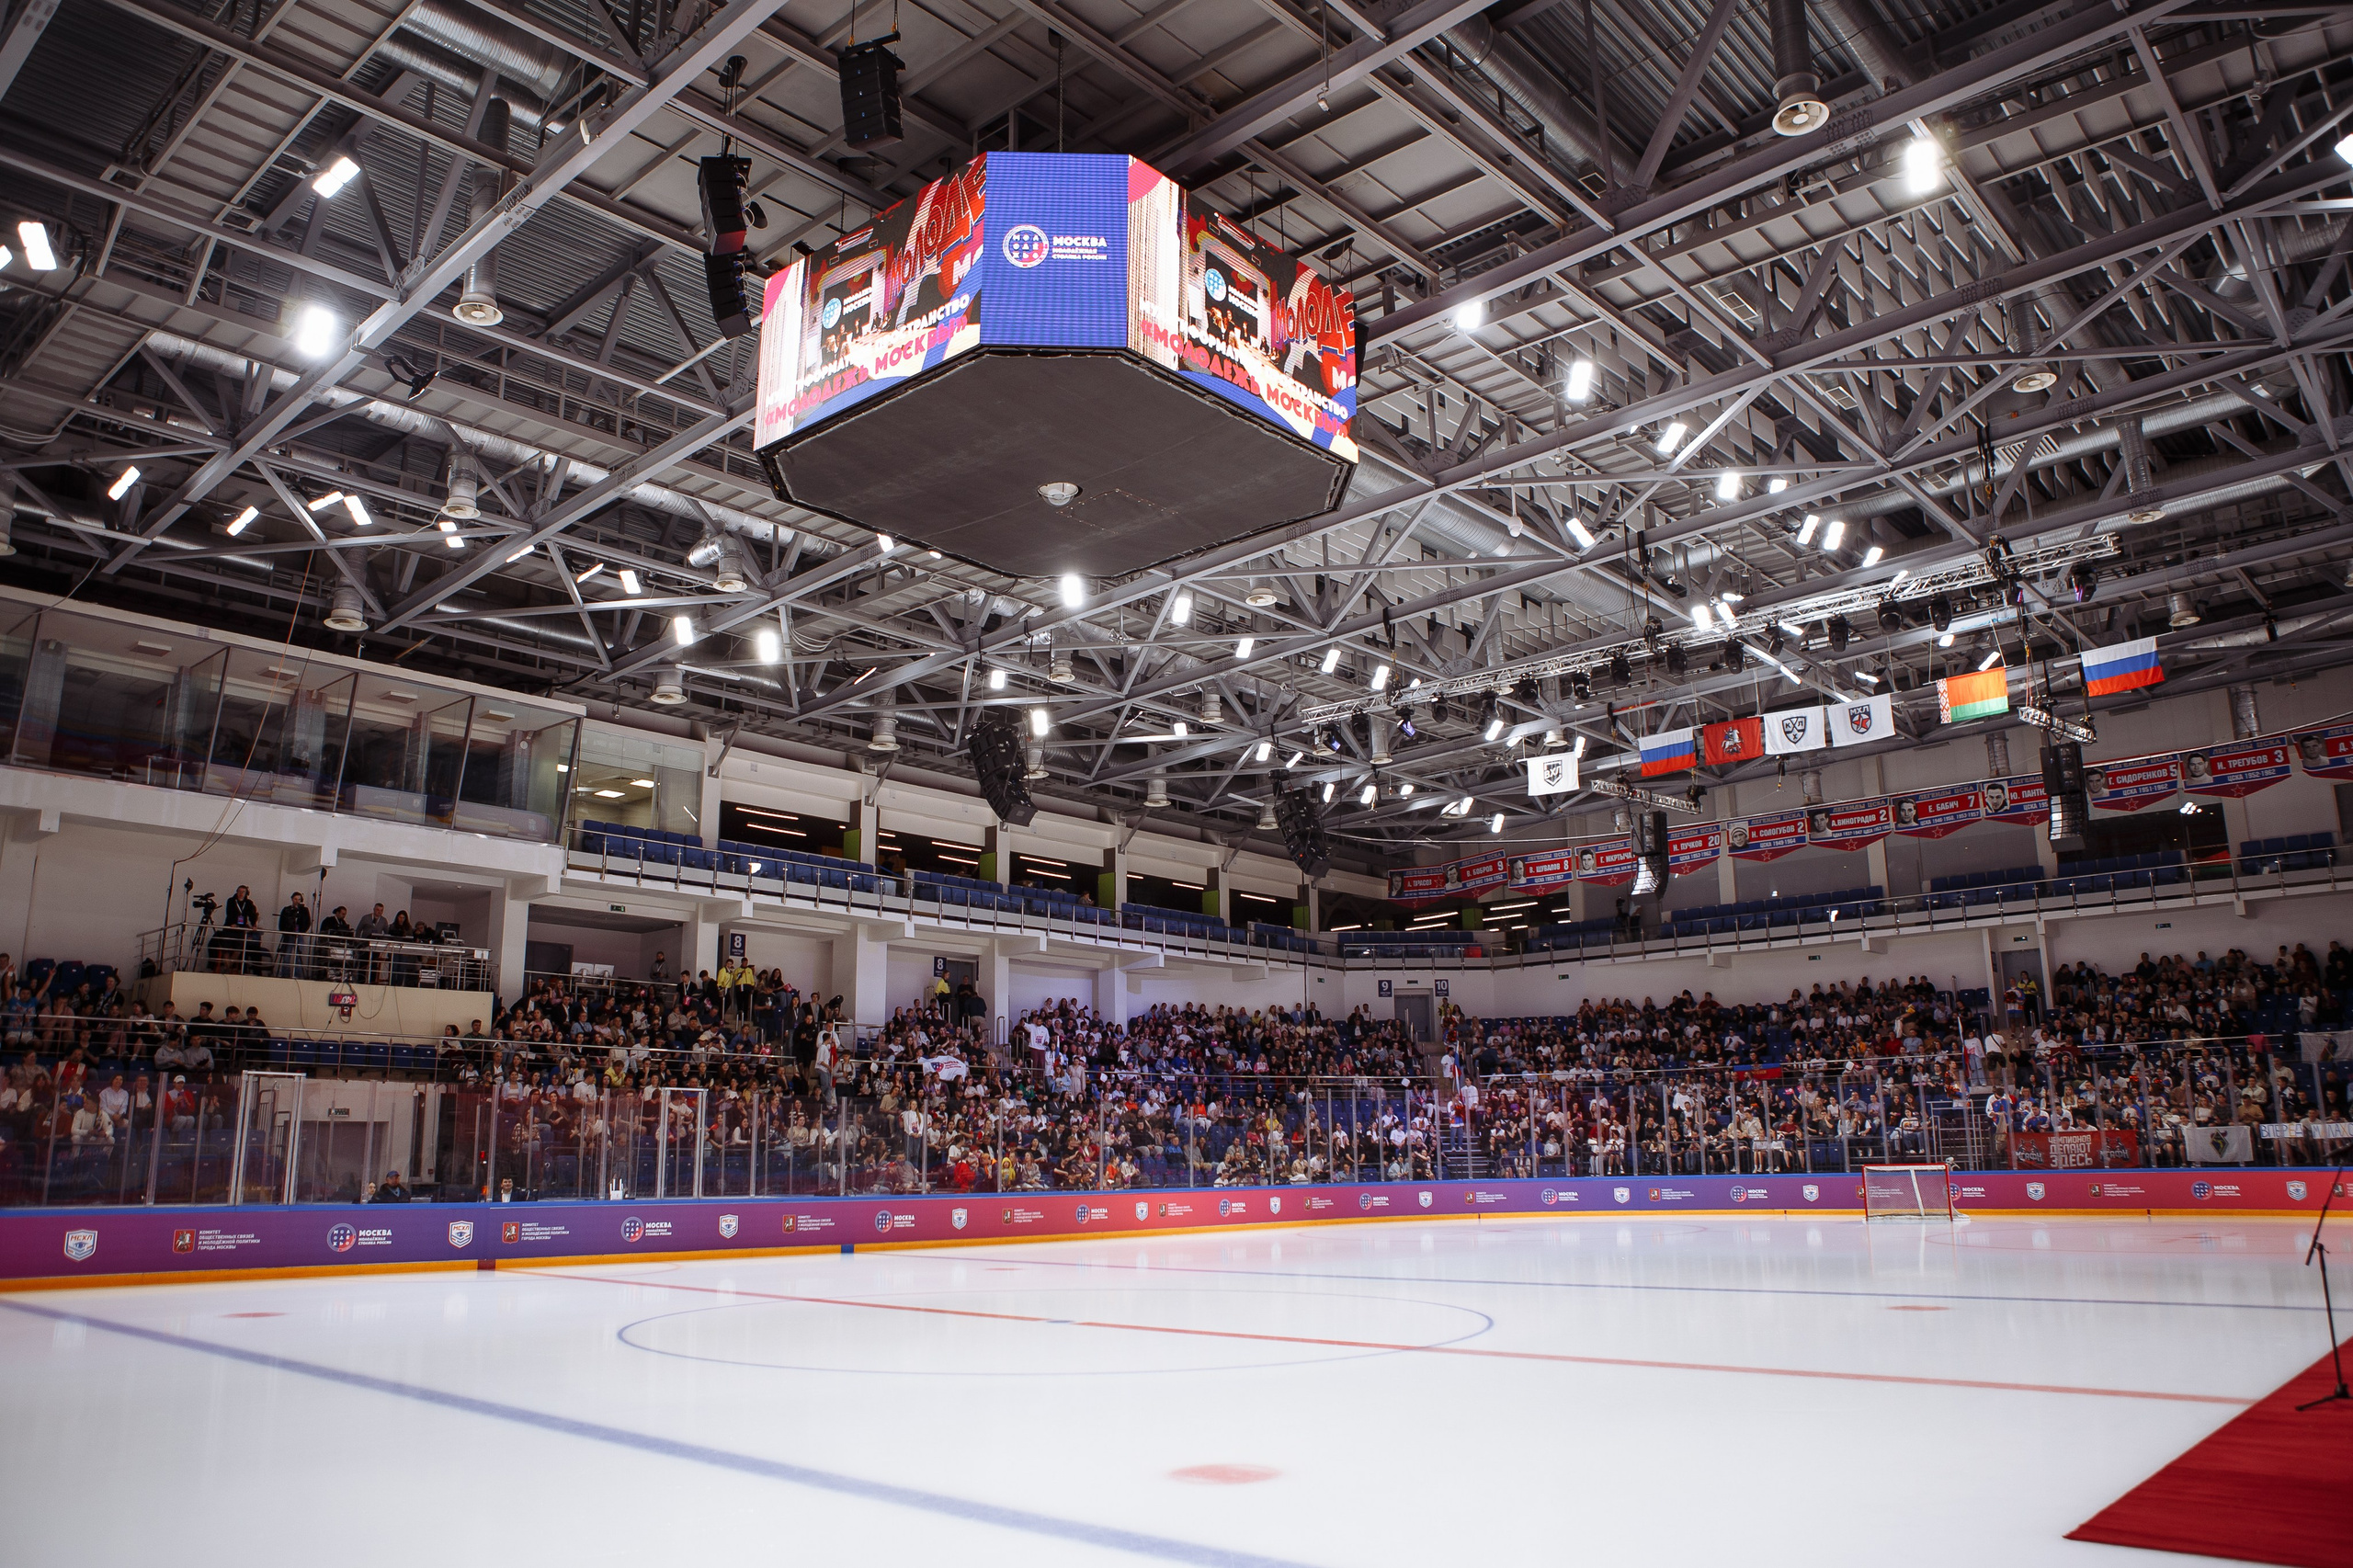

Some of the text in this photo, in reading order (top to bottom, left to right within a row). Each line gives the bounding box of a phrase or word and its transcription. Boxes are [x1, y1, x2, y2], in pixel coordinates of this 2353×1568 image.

[1052, 235, 1108, 247] МОСКВА
[1850, 707, 1870, 716] МХЛ
[2228, 755, 2268, 768] ТРЕГУБОВ
[2274, 750, 2284, 763] 3
[1544, 765, 1562, 779] ВХЛ
[2109, 764, 2177, 785] Г. СИДОРЕНКОВ 5
[1936, 801, 1959, 812] БАБИЧ
[1968, 795, 1975, 807] 7
[1879, 809, 1887, 822] 2
[1759, 825, 1795, 837] СОЛОГУБОВ
[1797, 822, 1804, 833] 2
[1680, 840, 1703, 850] ПУЧКОВ
[1708, 835, 1720, 846] 20
[1472, 865, 1493, 875] БОБРОВ
[1497, 860, 1504, 870] 9
[1563, 859, 1569, 870] 8
[734, 936, 742, 948] 8
[938, 959, 943, 970] 8
[1381, 981, 1389, 991] 9
[1436, 980, 1448, 991] 10
[2048, 1134, 2091, 1143] ЧЕМПИОНОВ
[2050, 1142, 2092, 1153] ДЕЛАЮТ
[2050, 1153, 2093, 1167] ЗДЕСЬ
